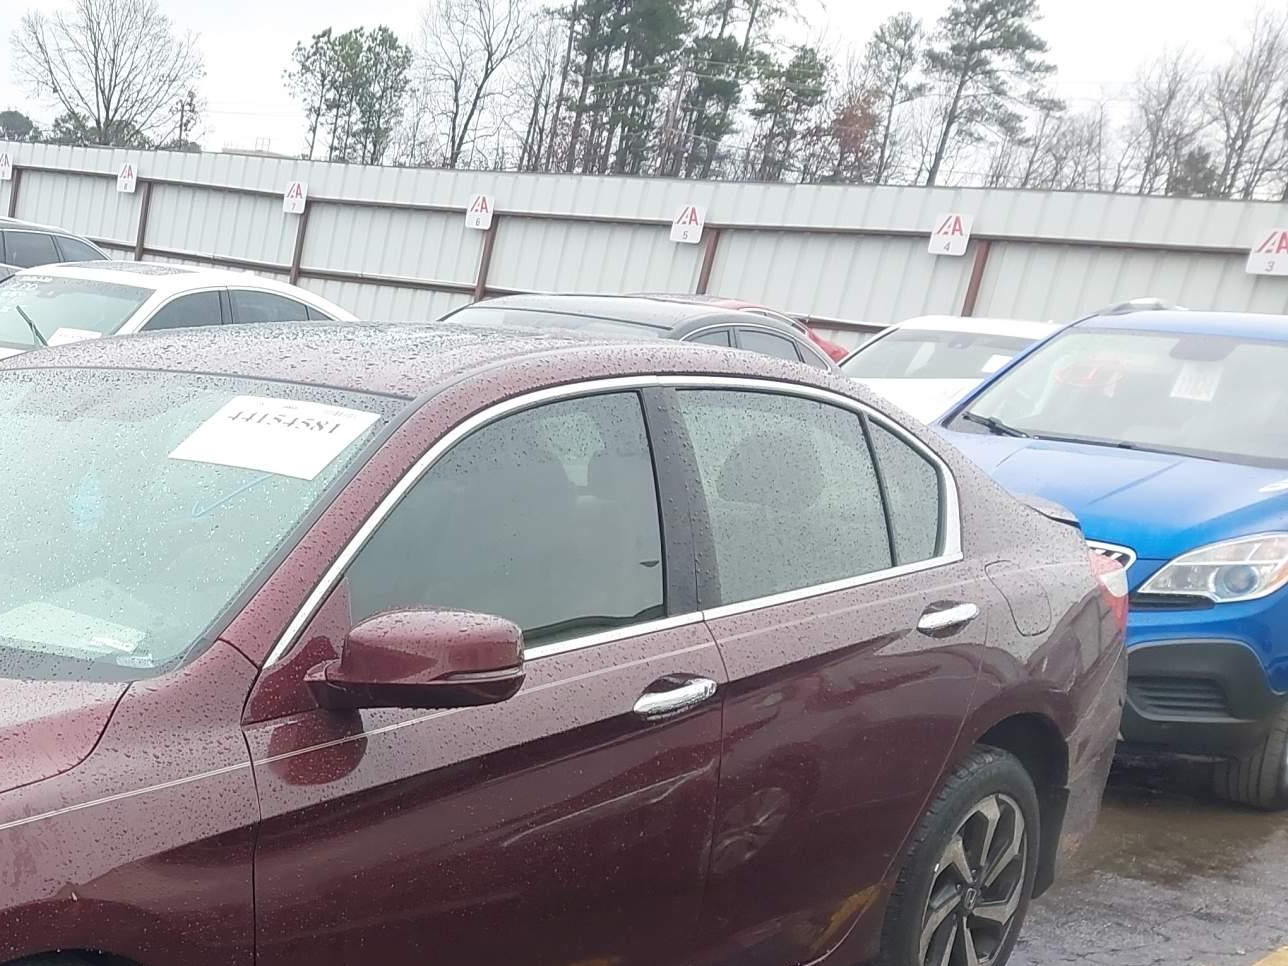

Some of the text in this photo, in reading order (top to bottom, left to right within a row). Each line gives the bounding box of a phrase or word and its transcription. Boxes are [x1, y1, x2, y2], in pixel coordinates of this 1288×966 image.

[682, 230, 689, 240] 5
[943, 241, 951, 251] 4
[1264, 261, 1275, 272] 3
